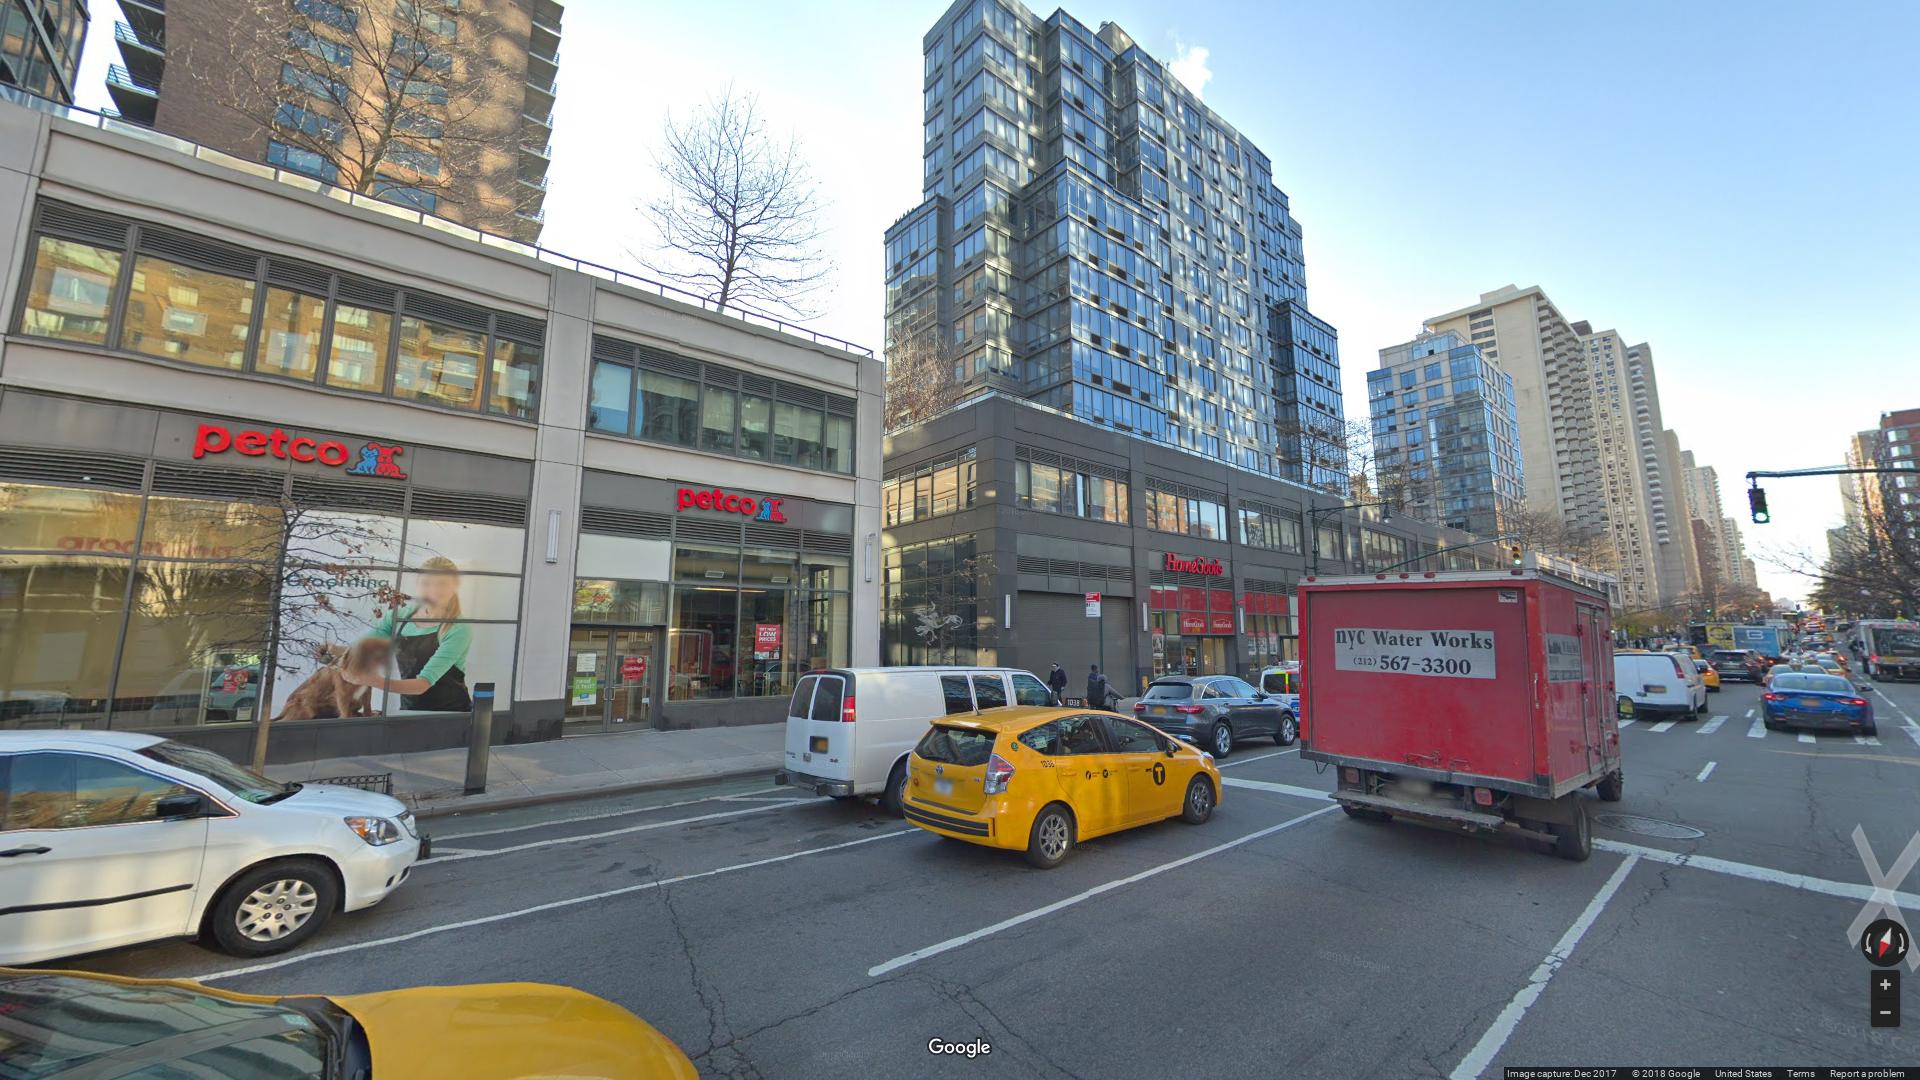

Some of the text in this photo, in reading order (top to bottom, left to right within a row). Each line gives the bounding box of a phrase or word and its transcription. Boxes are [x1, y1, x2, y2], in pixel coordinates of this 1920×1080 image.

[192, 423, 349, 466] petco
[677, 488, 757, 515] petco
[1166, 552, 1223, 576] HomeGoods
[1373, 631, 1423, 647] Water
[1430, 631, 1493, 649] Works
[1353, 655, 1472, 675] (212) 567-3300
